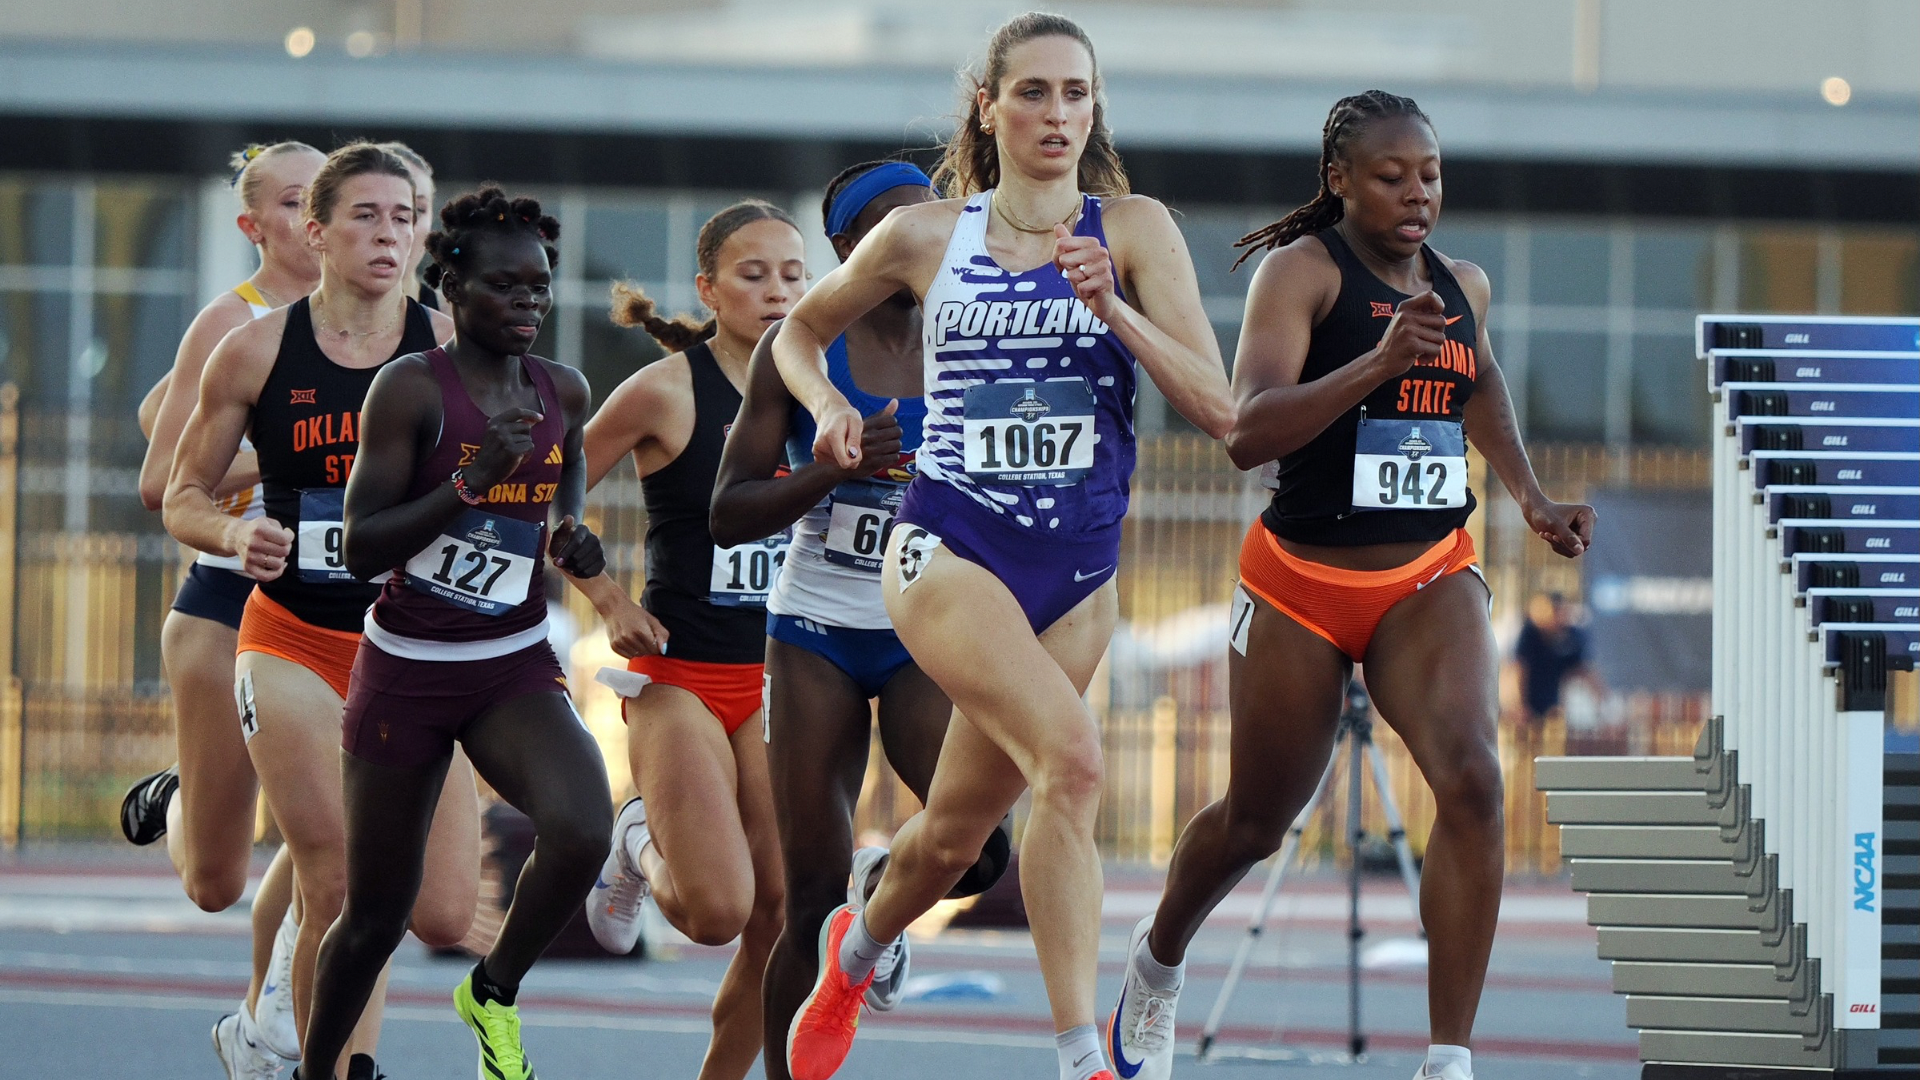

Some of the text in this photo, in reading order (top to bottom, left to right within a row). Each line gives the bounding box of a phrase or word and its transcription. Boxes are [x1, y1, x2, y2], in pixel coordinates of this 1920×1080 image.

[1784, 333, 1810, 344] GILL
[1796, 367, 1821, 378] GILL
[1397, 379, 1455, 414] STATE
[1810, 401, 1835, 411] GILL
[980, 422, 1083, 469] 1067
[1823, 435, 1848, 446] GILL
[997, 473, 1022, 481] COLLEGE
[1048, 471, 1066, 479] TEXAS
[1837, 470, 1862, 480] GILL
[1379, 461, 1448, 506] 942
[1851, 504, 1876, 514] GILL
[1865, 537, 1891, 548] GILL
[431, 543, 511, 597] 127
[1880, 572, 1906, 582] GILL
[430, 586, 454, 599] COLLEGE
[477, 600, 495, 610] TEXAS
[1894, 607, 1920, 617] GILL
[1854, 832, 1875, 913] NCAA
[1849, 1003, 1877, 1013] GILL
